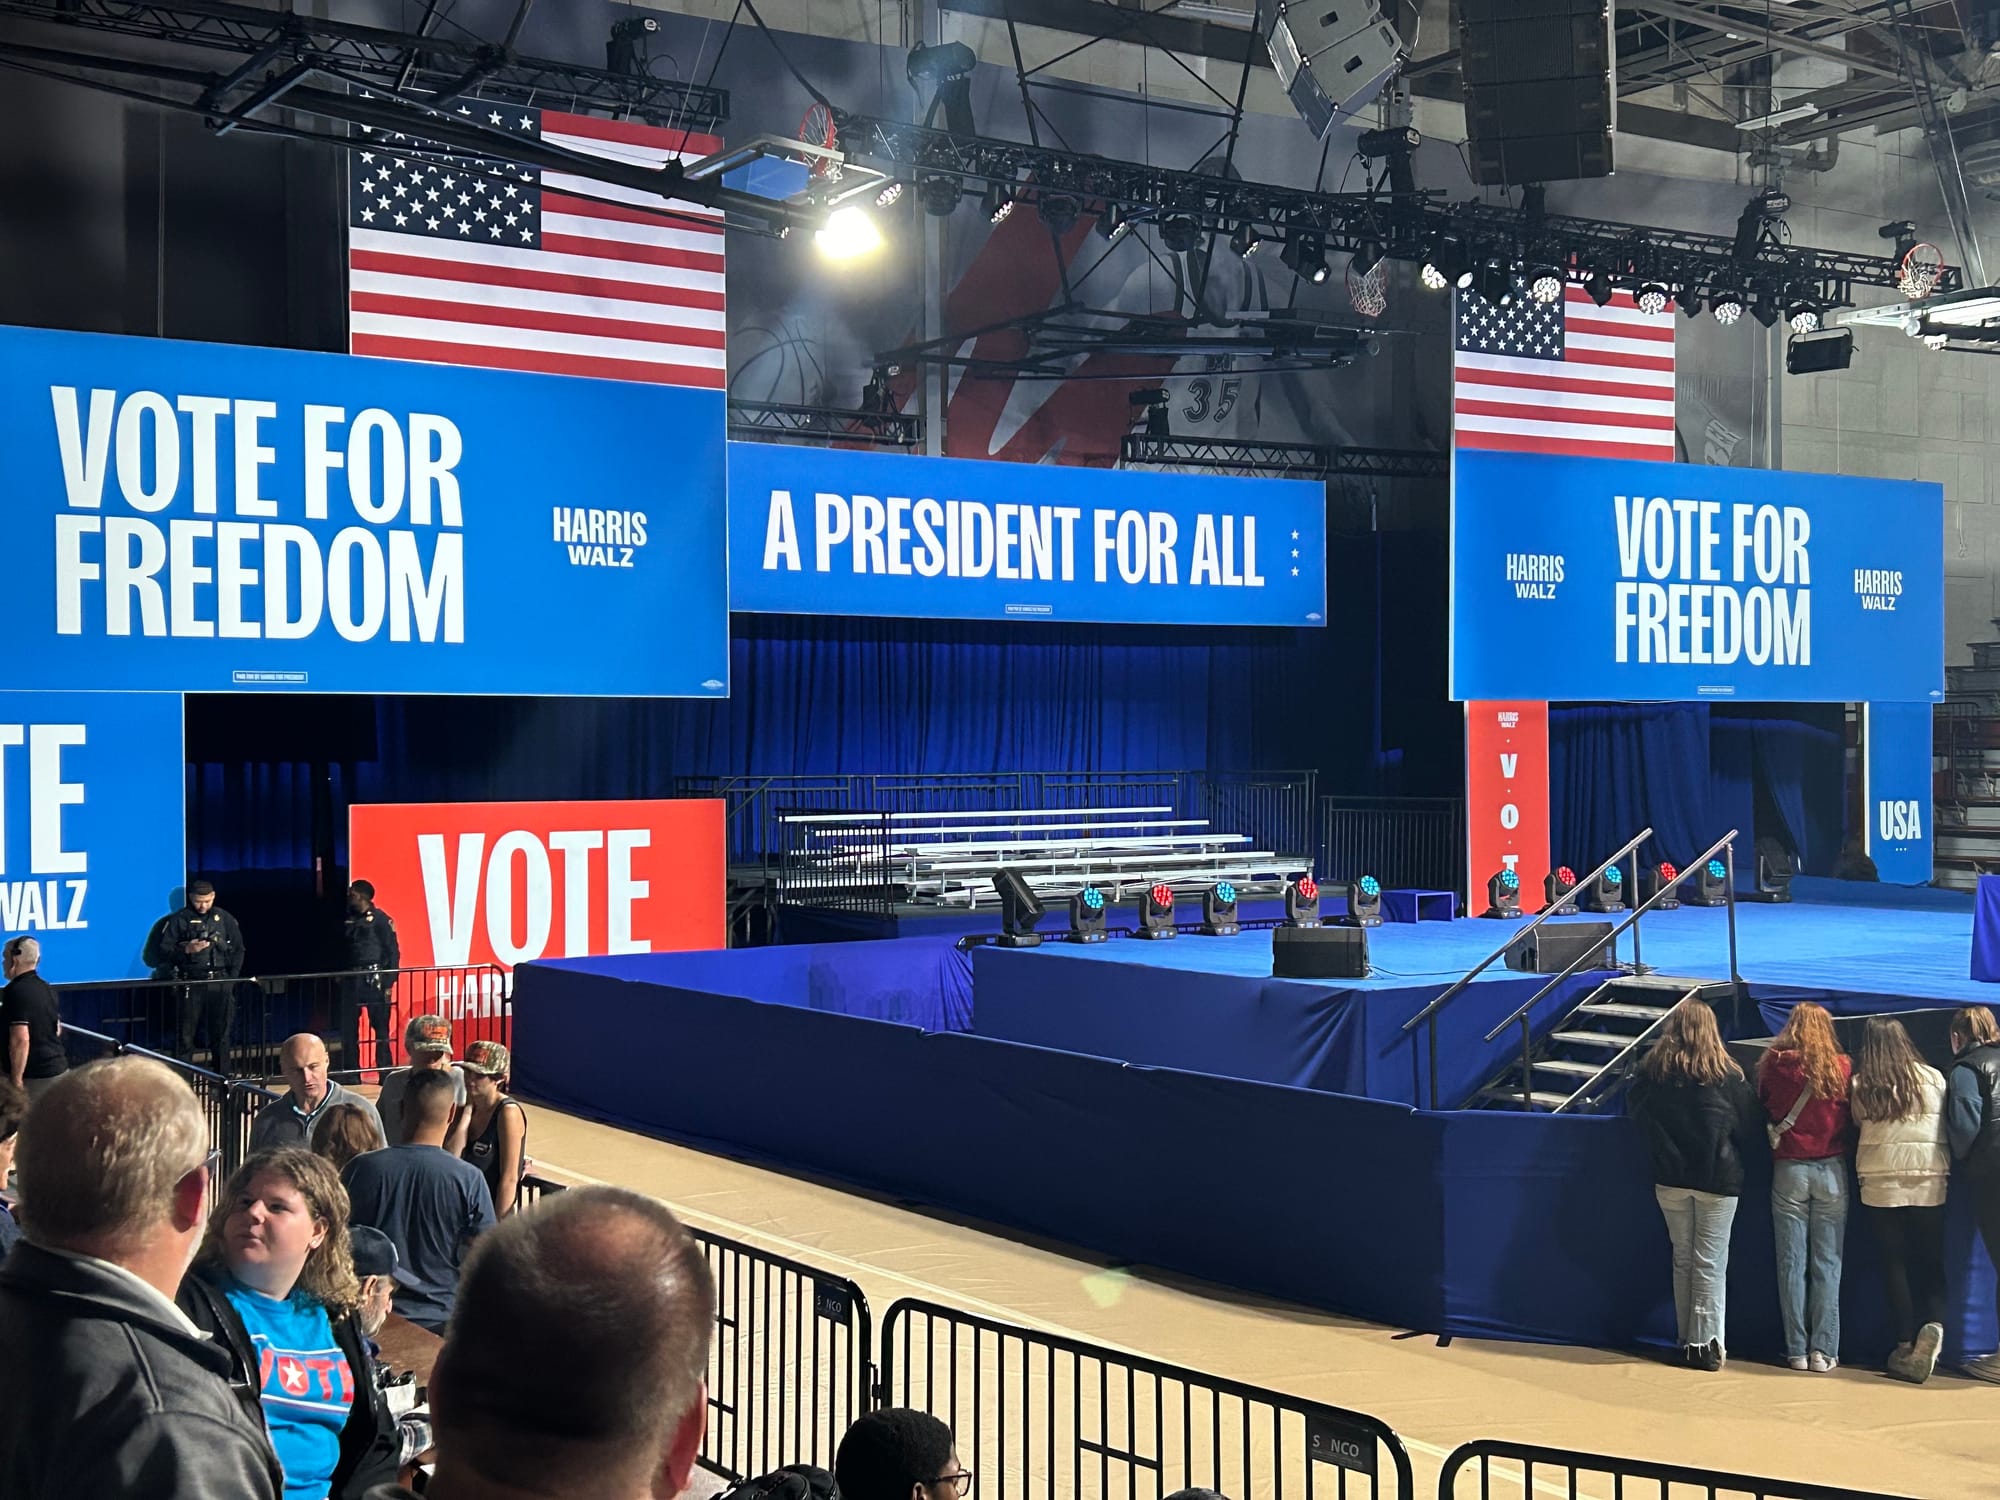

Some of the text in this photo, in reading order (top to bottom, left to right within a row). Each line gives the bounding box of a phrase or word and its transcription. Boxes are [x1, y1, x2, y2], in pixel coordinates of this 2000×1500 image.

[1183, 377, 1241, 423] 35
[51, 386, 463, 527] VOTE FOR
[553, 507, 647, 546] HARRIS
[763, 491, 1264, 586] A PRESIDENT FOR ALL
[1614, 496, 1810, 584] VOTE FOR
[568, 545, 633, 568] WALZ
[1506, 554, 1564, 582] HARRIS
[56, 515, 464, 643] FREEDOM
[1515, 583, 1555, 599] WALZ
[1854, 569, 1902, 595] HARRIS
[1615, 582, 1810, 665] FREEDOM
[1861, 596, 1895, 611] WALZ
[1880, 800, 1922, 841] USA
[417, 829, 652, 966] VOTE
